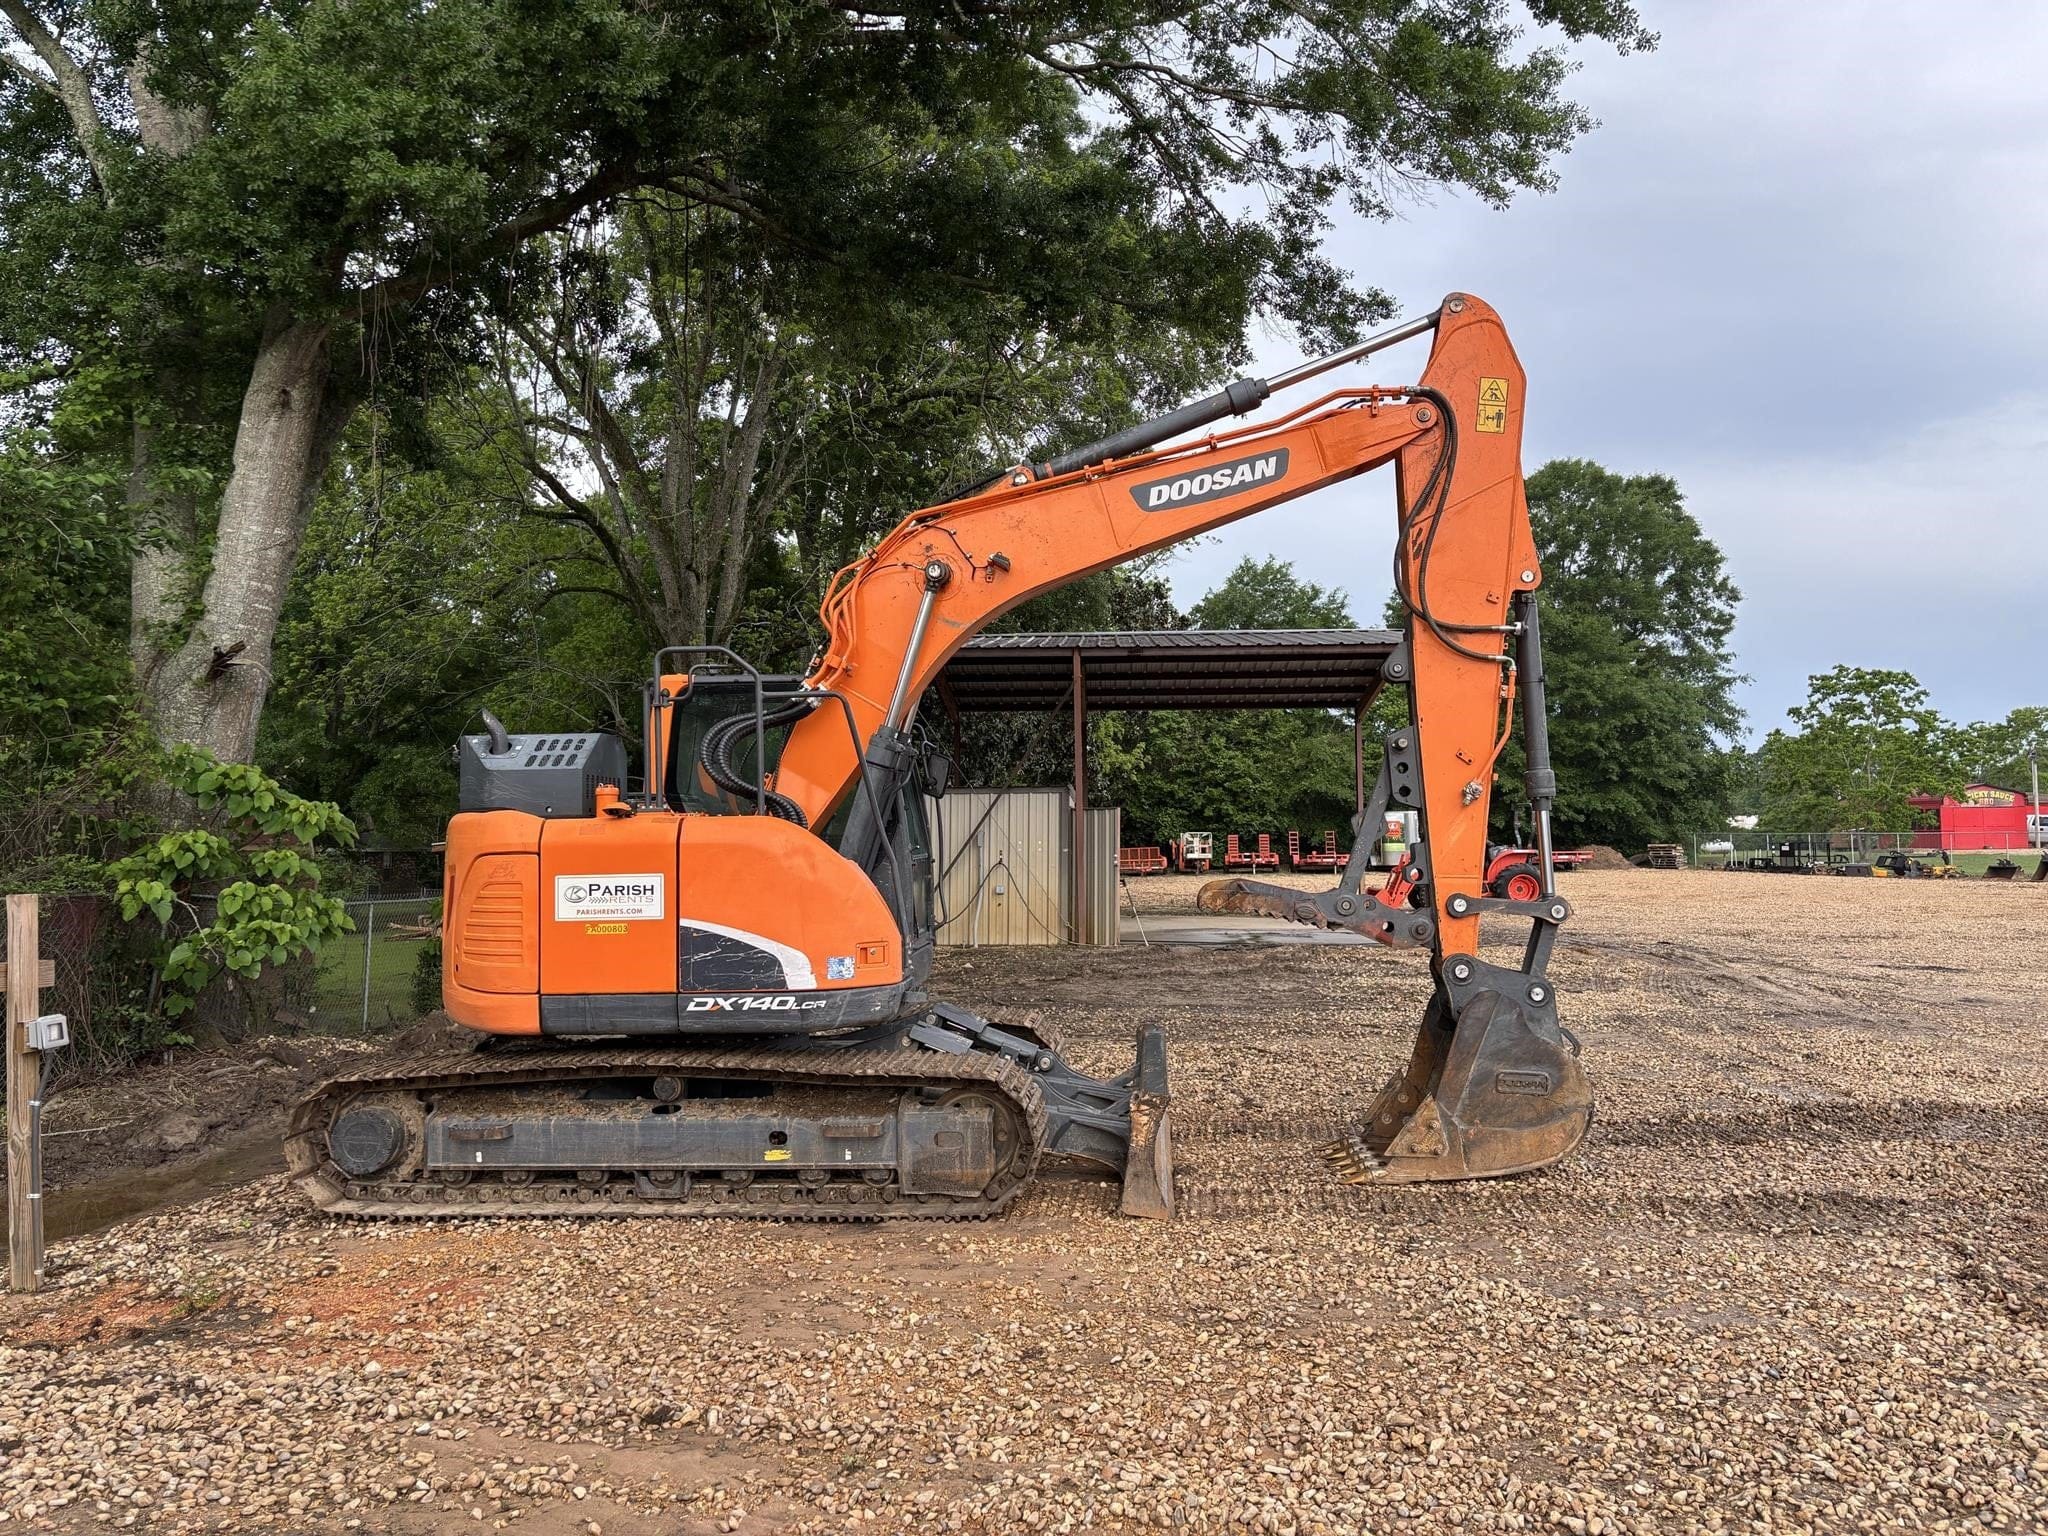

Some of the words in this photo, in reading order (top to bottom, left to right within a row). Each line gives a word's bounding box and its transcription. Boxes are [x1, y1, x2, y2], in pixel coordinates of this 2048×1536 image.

[1148, 456, 1277, 507] DOOSAN
[1990, 790, 2014, 802] SAUCE
[588, 883, 654, 896] PARISH
[609, 895, 654, 904] RENTS
[576, 907, 643, 916] PARISHRENTS.COM
